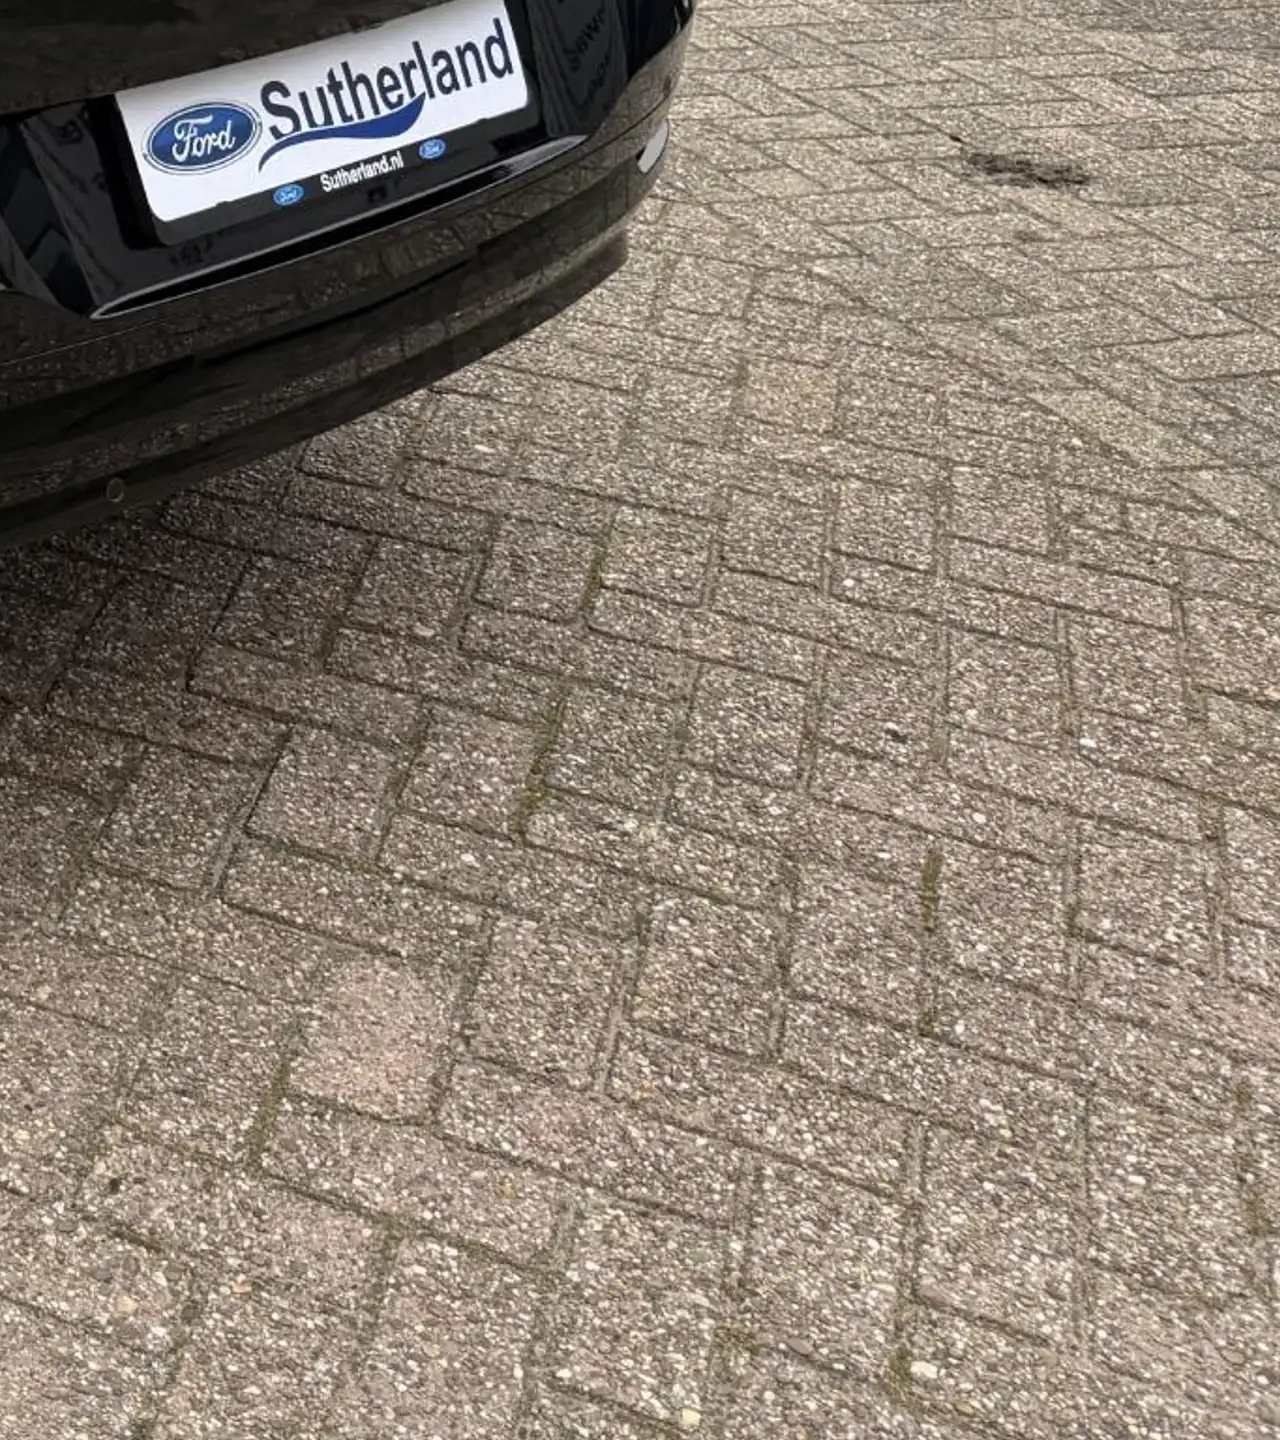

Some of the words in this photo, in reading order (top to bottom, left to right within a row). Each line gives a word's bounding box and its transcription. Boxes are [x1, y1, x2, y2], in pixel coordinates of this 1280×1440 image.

[171, 114, 237, 162] Ford
[260, 17, 514, 140] Sutherland
[319, 150, 405, 193] Sutherland.nl
